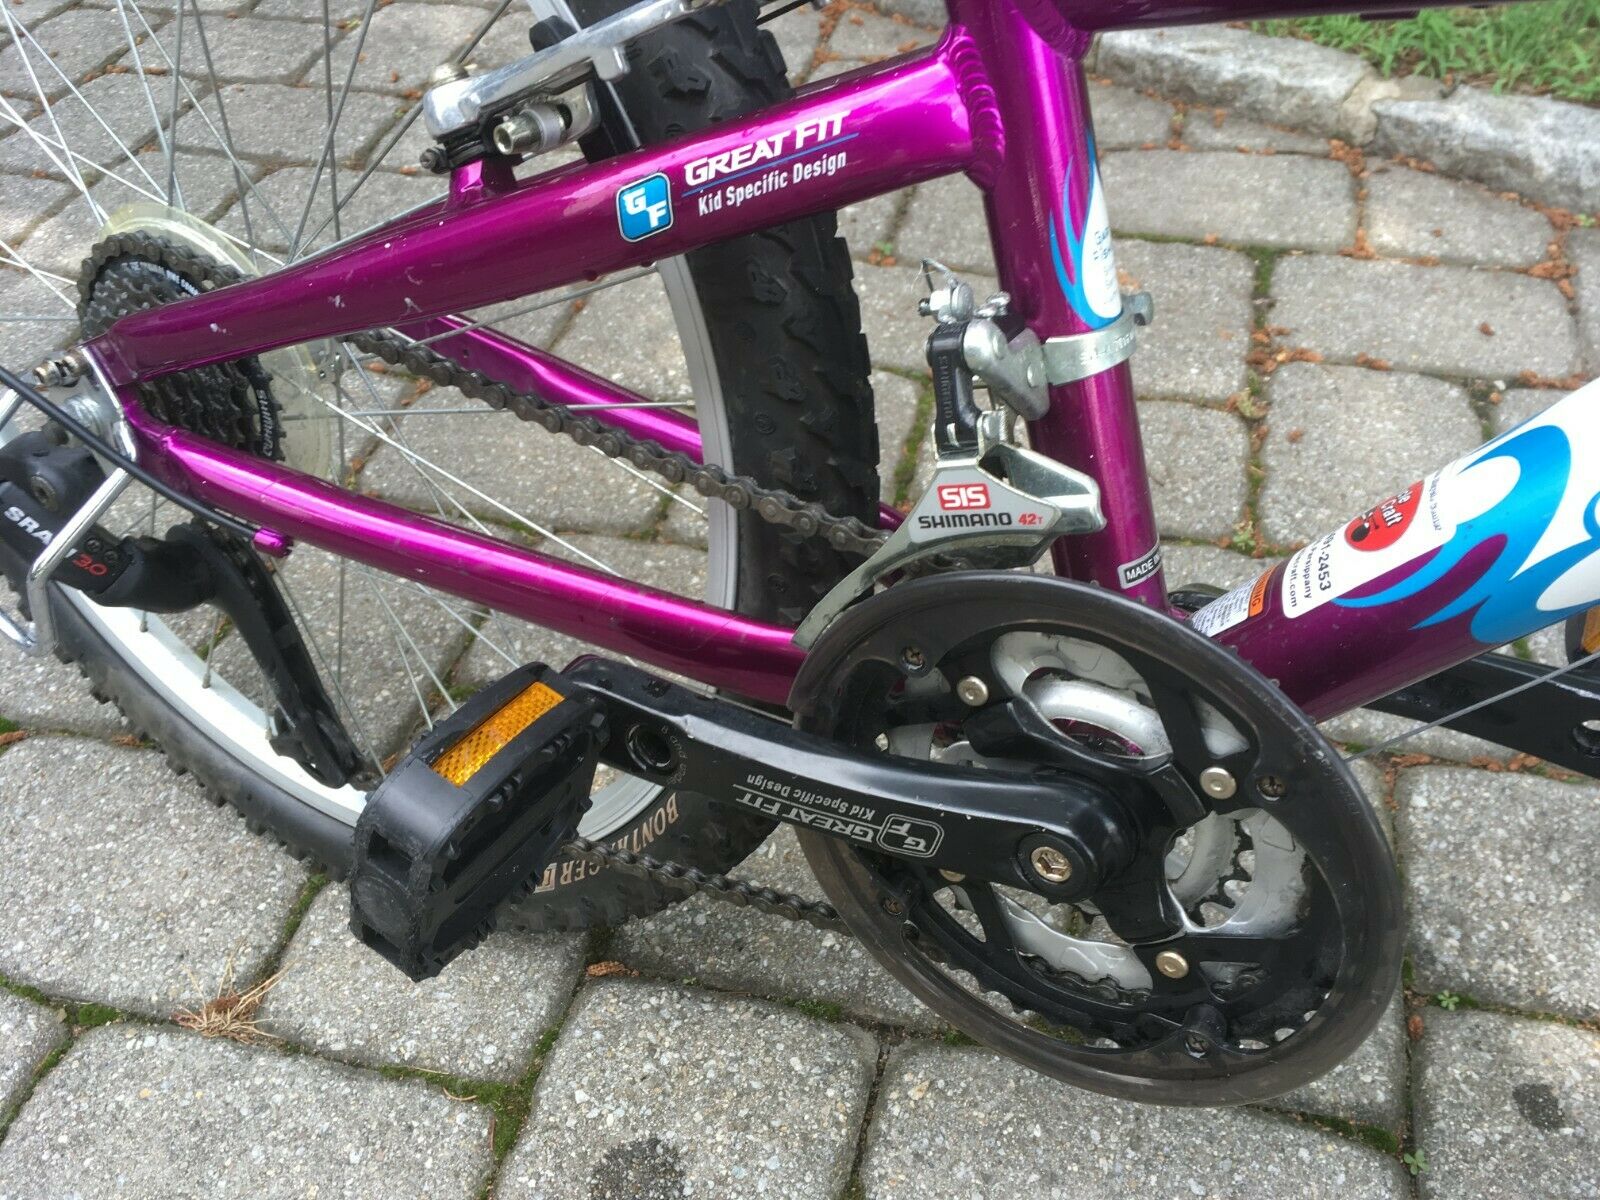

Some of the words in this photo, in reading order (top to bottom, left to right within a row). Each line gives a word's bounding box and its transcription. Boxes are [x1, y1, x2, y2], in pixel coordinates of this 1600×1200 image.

[684, 131, 790, 186] GREAT
[794, 110, 852, 150] FIT
[698, 189, 722, 216] Kid
[726, 170, 788, 207] Specific
[793, 151, 847, 184] Design
[941, 486, 987, 508] SIS
[918, 512, 1012, 529] SHIMANO
[1018, 513, 1043, 526] 42T
[72, 553, 108, 576] 3.0
[1126, 558, 1154, 580] MADE
[747, 774, 789, 797] Design
[736, 792, 782, 817] FIT
[793, 788, 849, 813] Specific
[850, 805, 876, 821] Kid
[781, 808, 875, 844] GREAT
[561, 792, 680, 886] BONTGER
